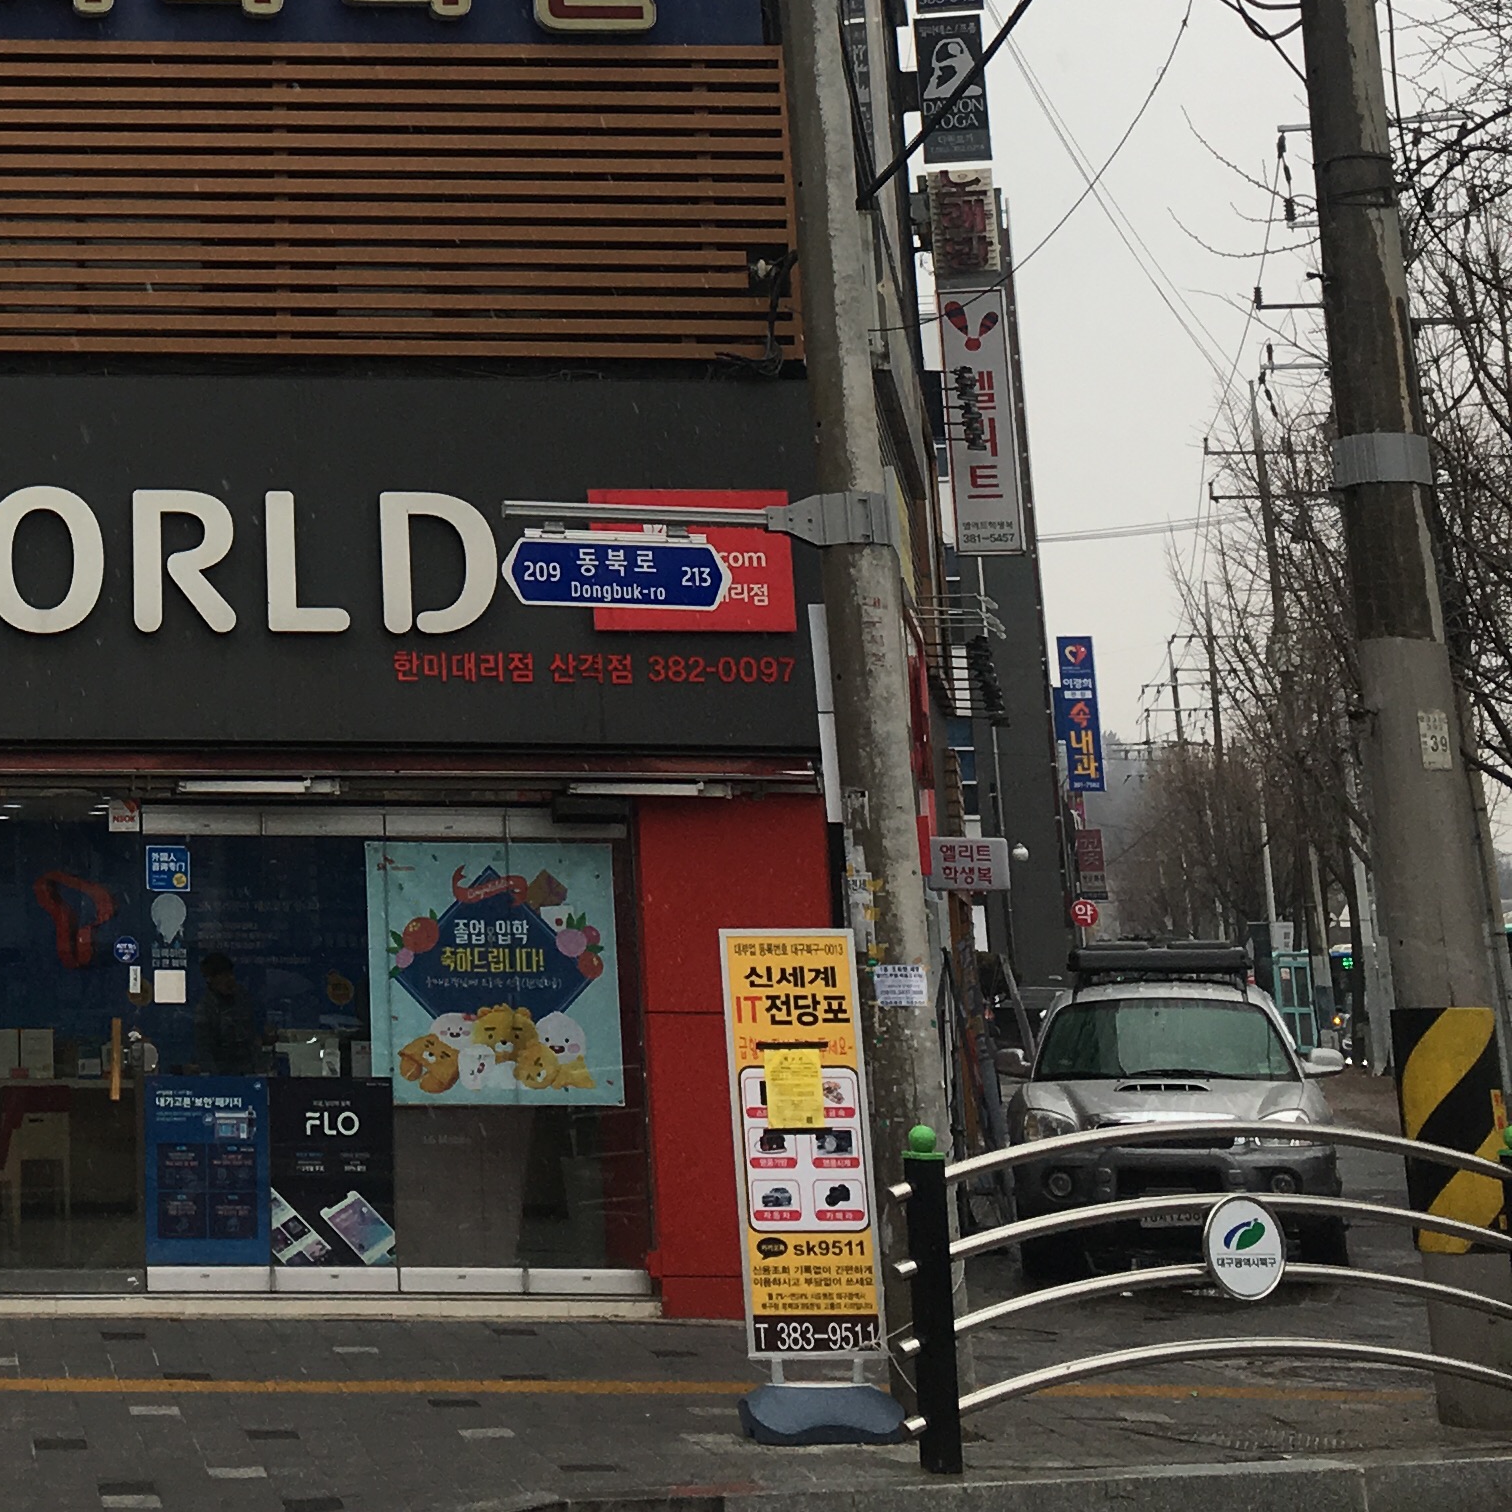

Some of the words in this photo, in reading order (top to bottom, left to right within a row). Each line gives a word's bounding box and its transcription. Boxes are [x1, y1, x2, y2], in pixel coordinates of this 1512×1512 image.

[935, 113, 979, 129] OGA
[963, 533, 1016, 544] 381-5457
[523, 561, 561, 582] 209
[576, 549, 658, 576] 동북로
[681, 566, 712, 587] 213
[571, 581, 666, 602] Dongbuk-ro
[393, 650, 534, 683] 한미대리점
[549, 652, 634, 685] 산격점
[648, 656, 796, 684] 382-0097
[1430, 734, 1448, 753] 39
[939, 843, 992, 863] 엘리트
[942, 864, 993, 885] 학생복
[1074, 903, 1094, 924] 약
[440, 946, 545, 973] 축하드립니다!
[744, 965, 837, 988] 신세계
[736, 993, 851, 1026] IT전당포
[305, 1111, 360, 1136] FLO
[793, 1240, 865, 1256] sk9511
[1216, 1257, 1277, 1269] 대구광역시북구
[755, 1323, 769, 1350] T
[776, 1322, 876, 1351] 383-9511
